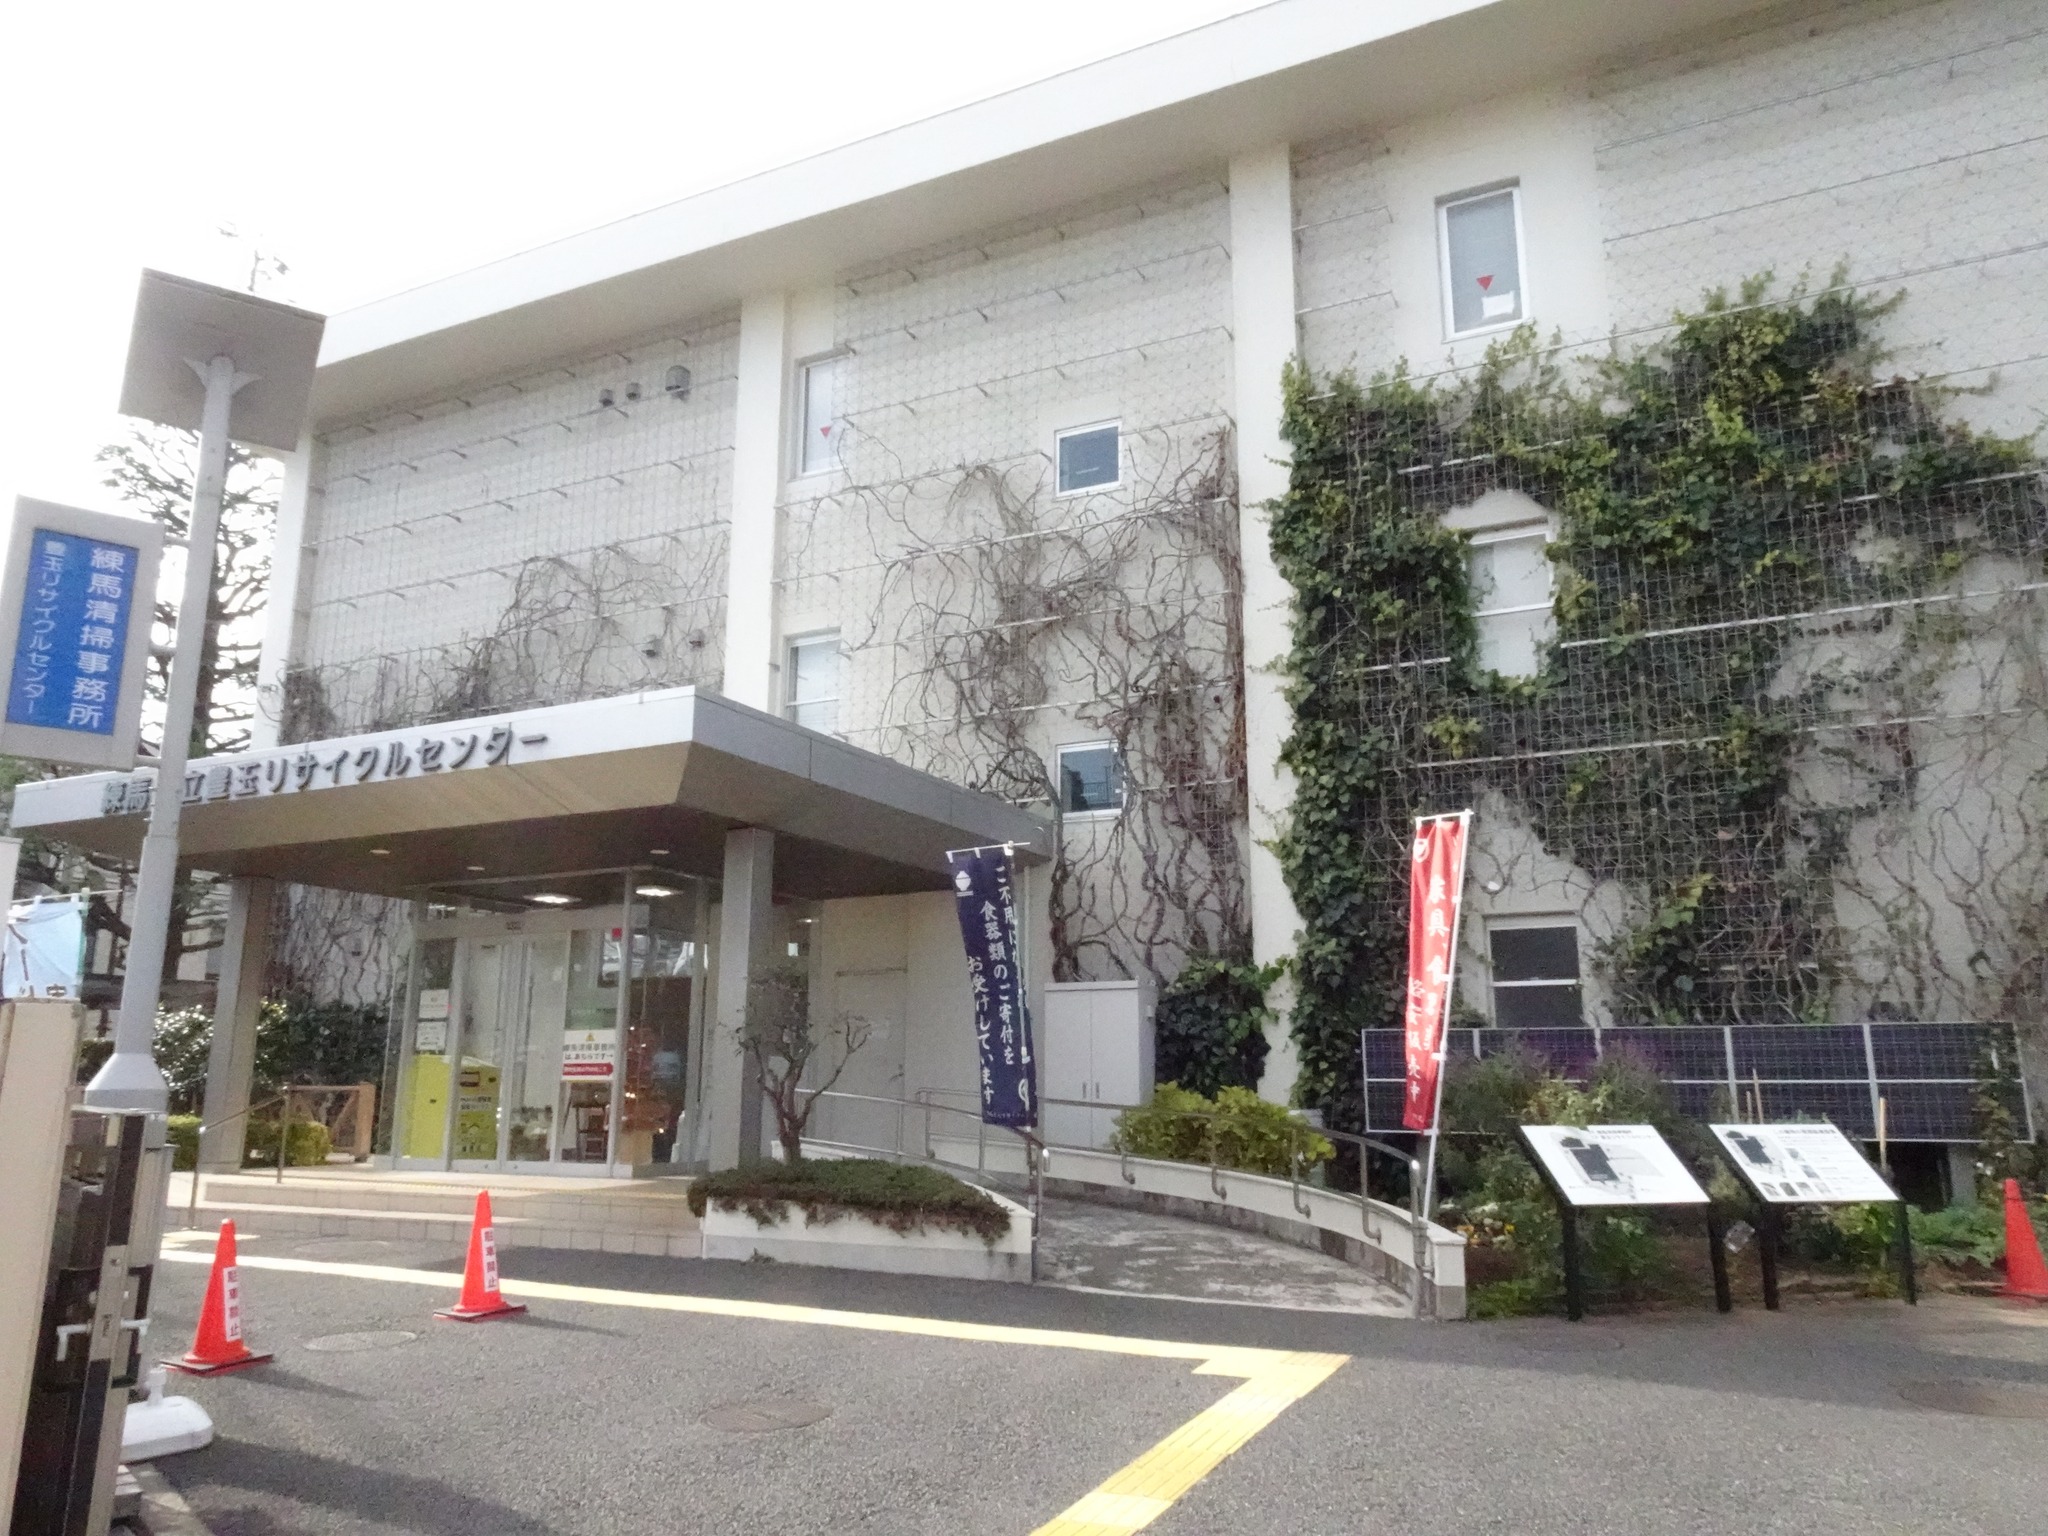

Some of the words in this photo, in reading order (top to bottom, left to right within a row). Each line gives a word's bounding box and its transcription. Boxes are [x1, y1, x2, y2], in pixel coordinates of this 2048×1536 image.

[23, 540, 67, 715] 豊玉リサイクルセンター
[67, 548, 126, 729] 練馬清掃事務所
[101, 726, 549, 815] 練馬立豊玉リサイクルセンター
[968, 955, 995, 1105] お受けしています
[979, 900, 1014, 1066] 食器類のご寄付を
